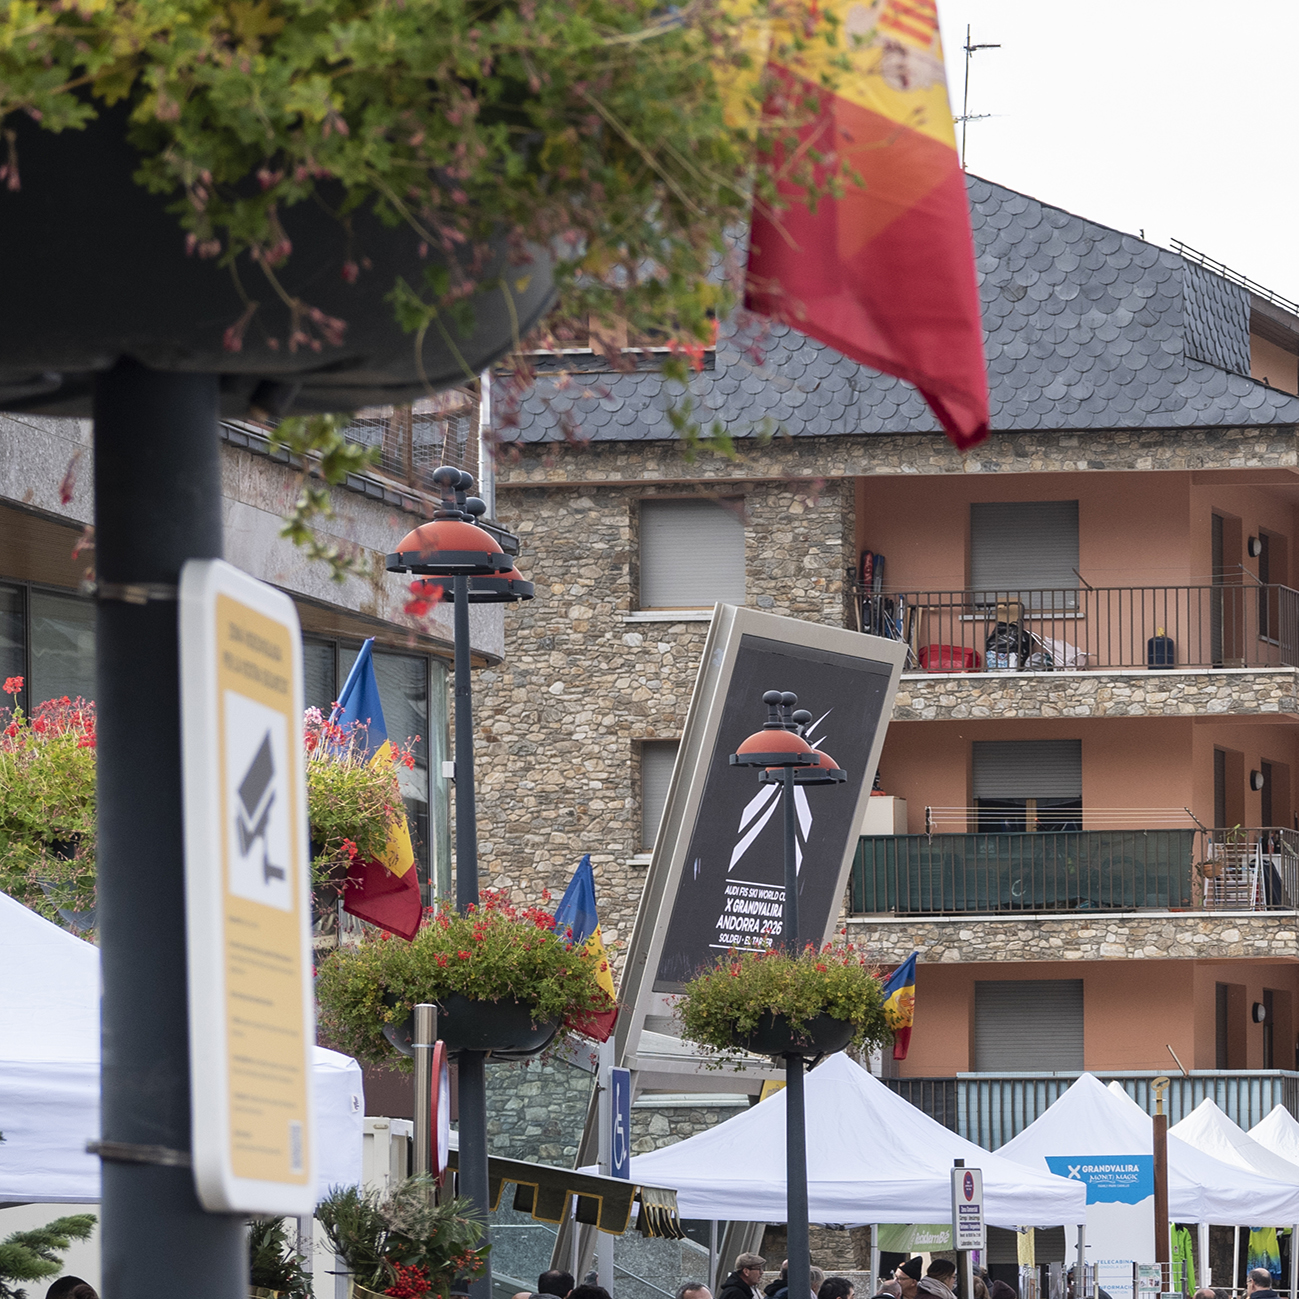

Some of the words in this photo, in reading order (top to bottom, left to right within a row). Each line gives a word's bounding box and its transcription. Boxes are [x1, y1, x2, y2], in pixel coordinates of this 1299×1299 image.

[724, 885, 740, 896] AUDI
[739, 886, 749, 897] FIS
[748, 888, 759, 898] SKI
[758, 889, 779, 901] WORLD
[724, 898, 734, 912] X
[733, 899, 783, 918] GRANDVALIRA
[715, 914, 760, 933] ANDORRA
[760, 919, 783, 935] 2026
[718, 933, 742, 945] SOLDEU
[1082, 1164, 1139, 1173] GRANDVALIRA
